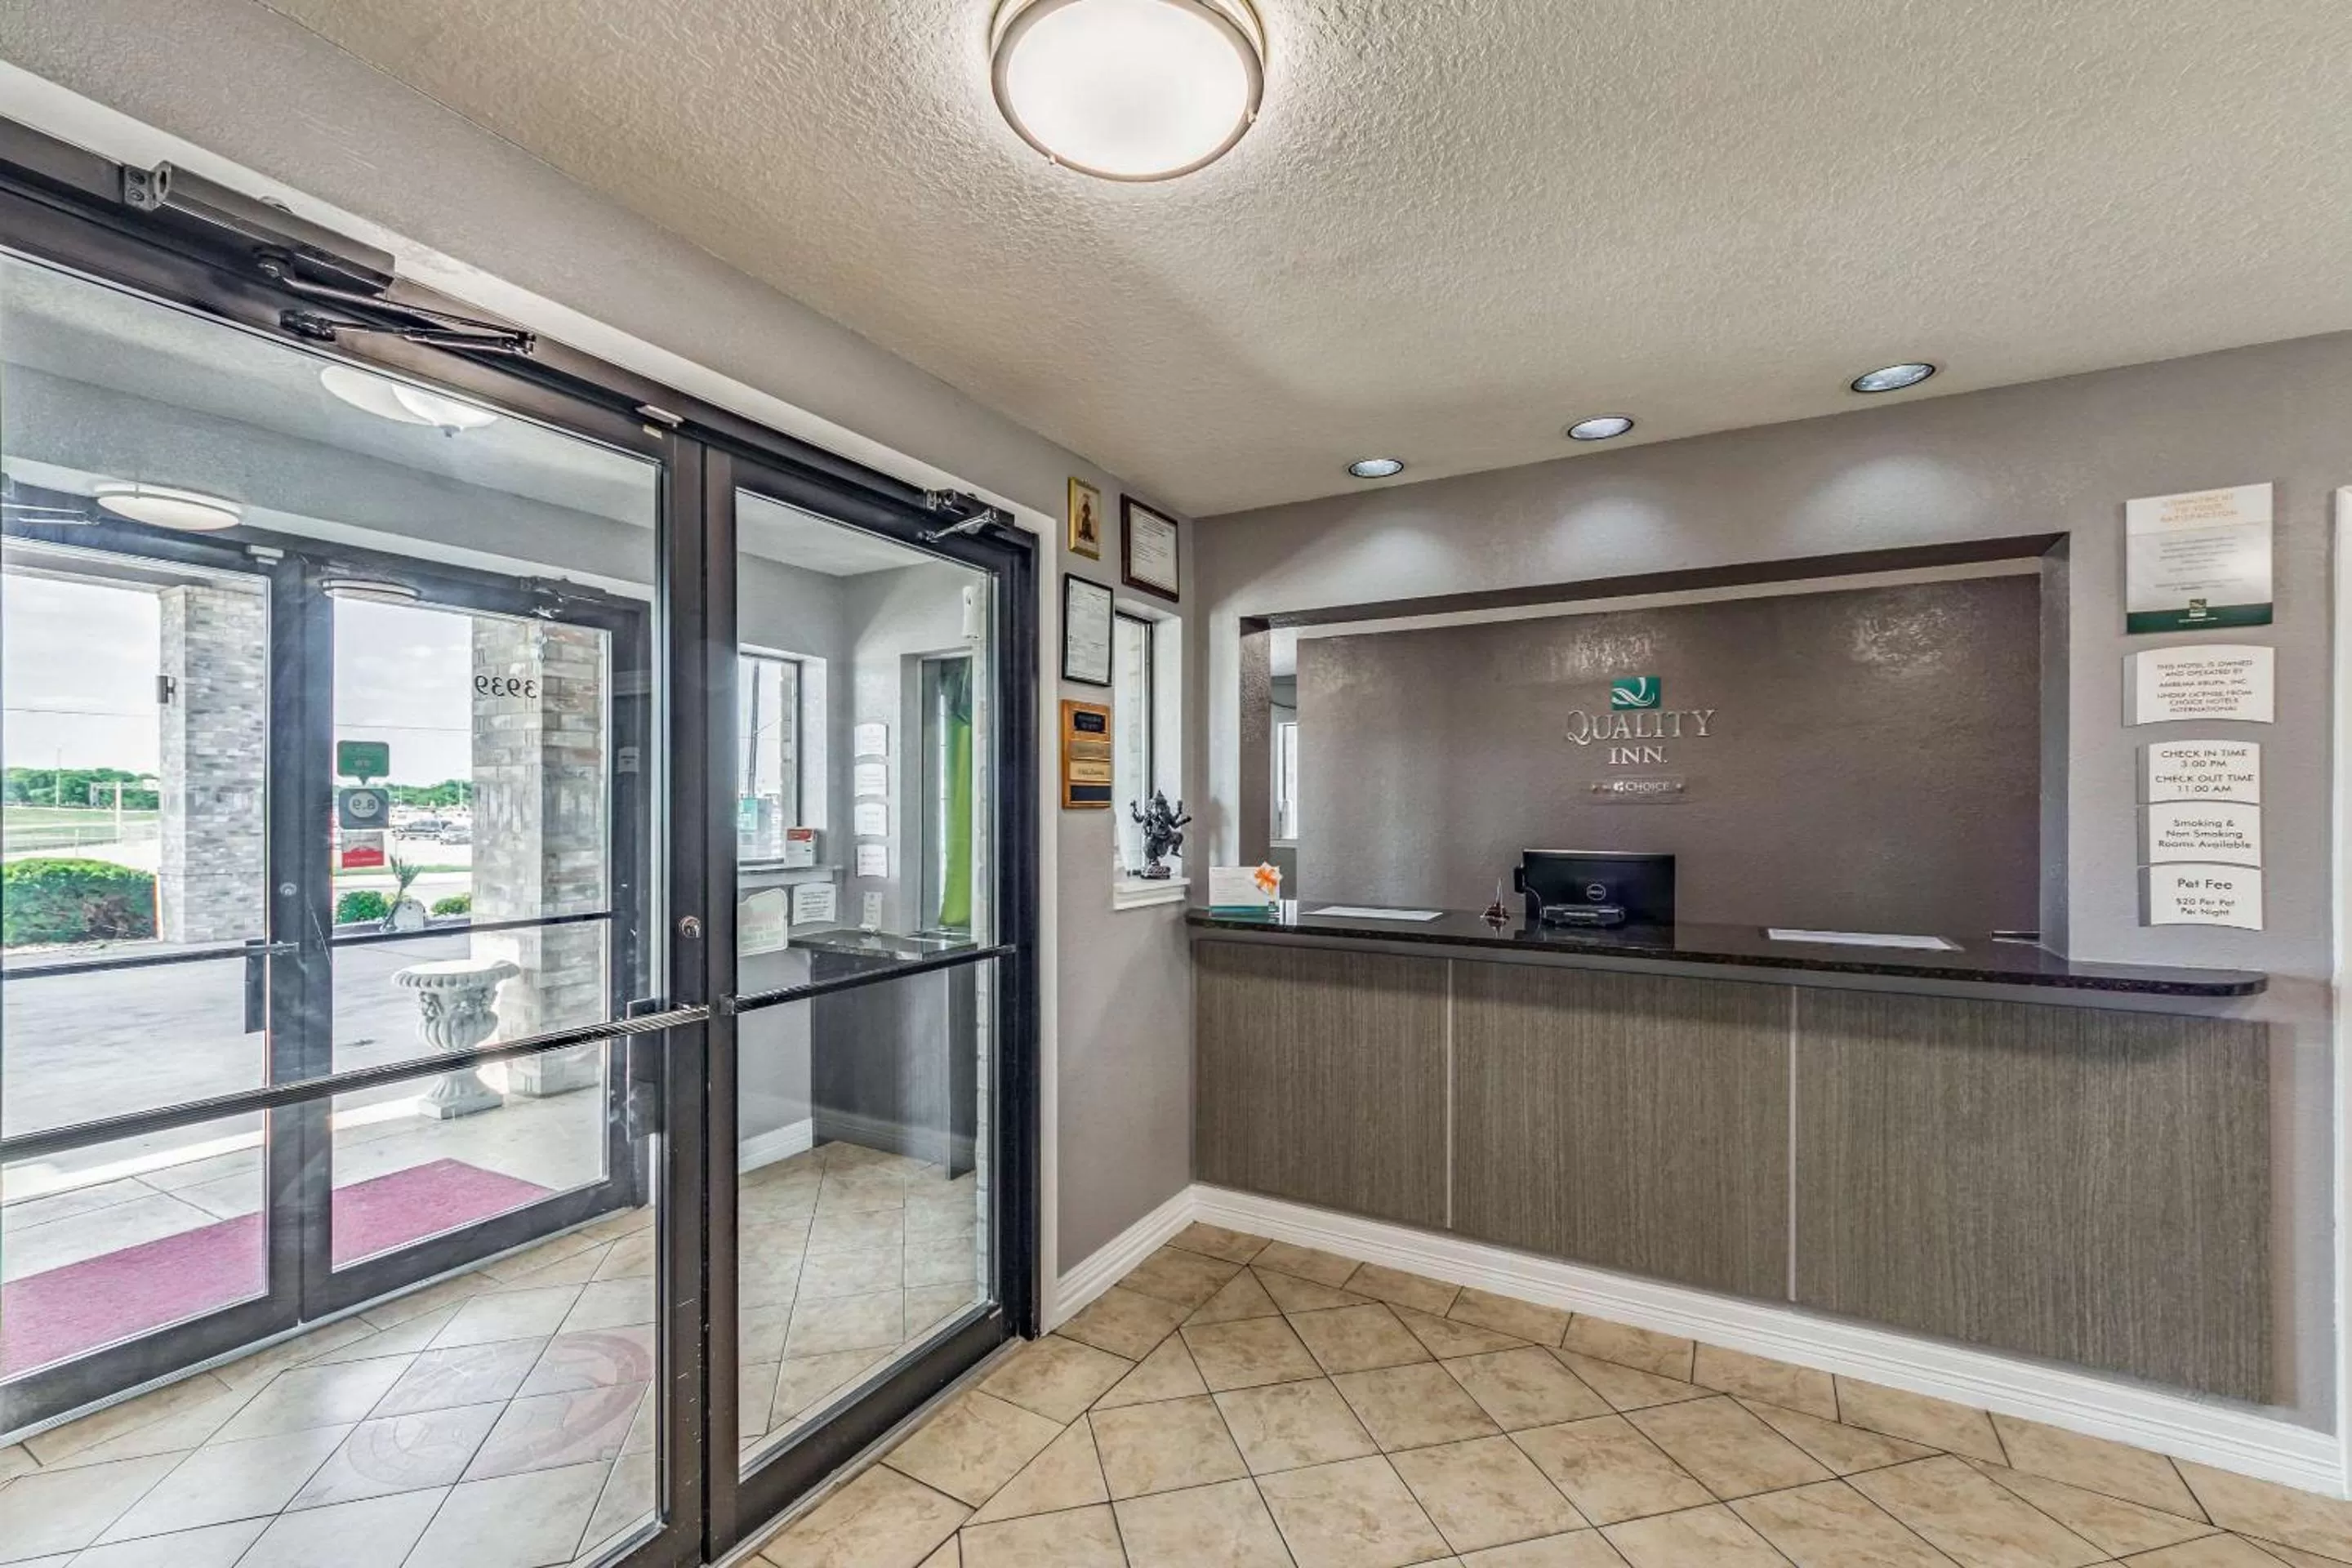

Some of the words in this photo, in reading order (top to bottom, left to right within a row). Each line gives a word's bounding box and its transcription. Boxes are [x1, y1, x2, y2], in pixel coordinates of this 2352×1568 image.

[2217, 659, 2252, 667] OWNED
[1566, 709, 1717, 746] QUALITY
[2161, 750, 2200, 758] CHECK
[2155, 775, 2194, 783] CHECK
[2198, 774, 2223, 782] OUT
[2173, 819, 2223, 828] Smoking
[2165, 830, 2189, 838] Non
[2193, 830, 2243, 840] Smoking
[2158, 840, 2195, 848] Rooms
[2198, 840, 2252, 849] Available
[2176, 877, 2199, 889] Pet
[2205, 879, 2233, 890] Fee
